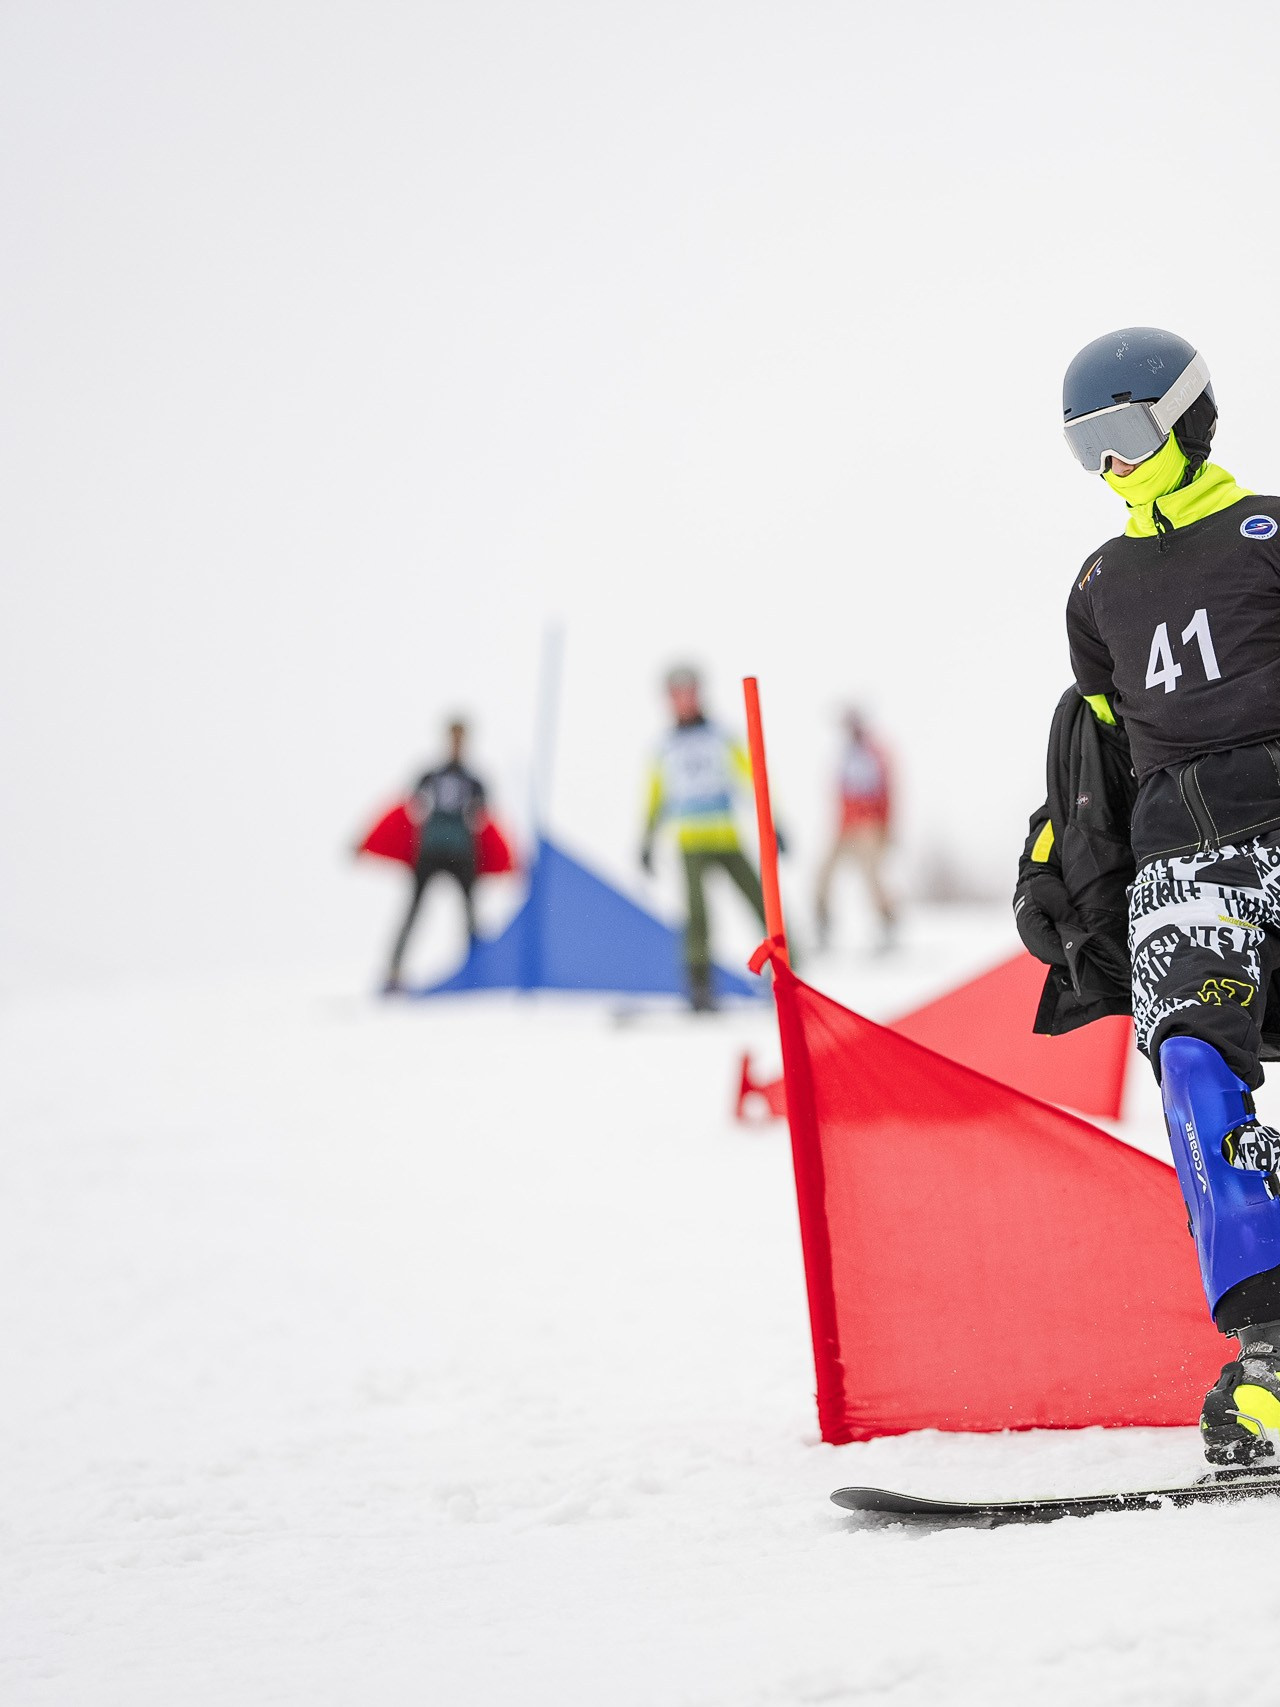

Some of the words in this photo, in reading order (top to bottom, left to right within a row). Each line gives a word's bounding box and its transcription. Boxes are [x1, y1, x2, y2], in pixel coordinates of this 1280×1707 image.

[1166, 374, 1201, 414] SMITH
[1145, 608, 1222, 694] 41
[1190, 926, 1234, 953] ITS
[1186, 1121, 1203, 1171] COBER
